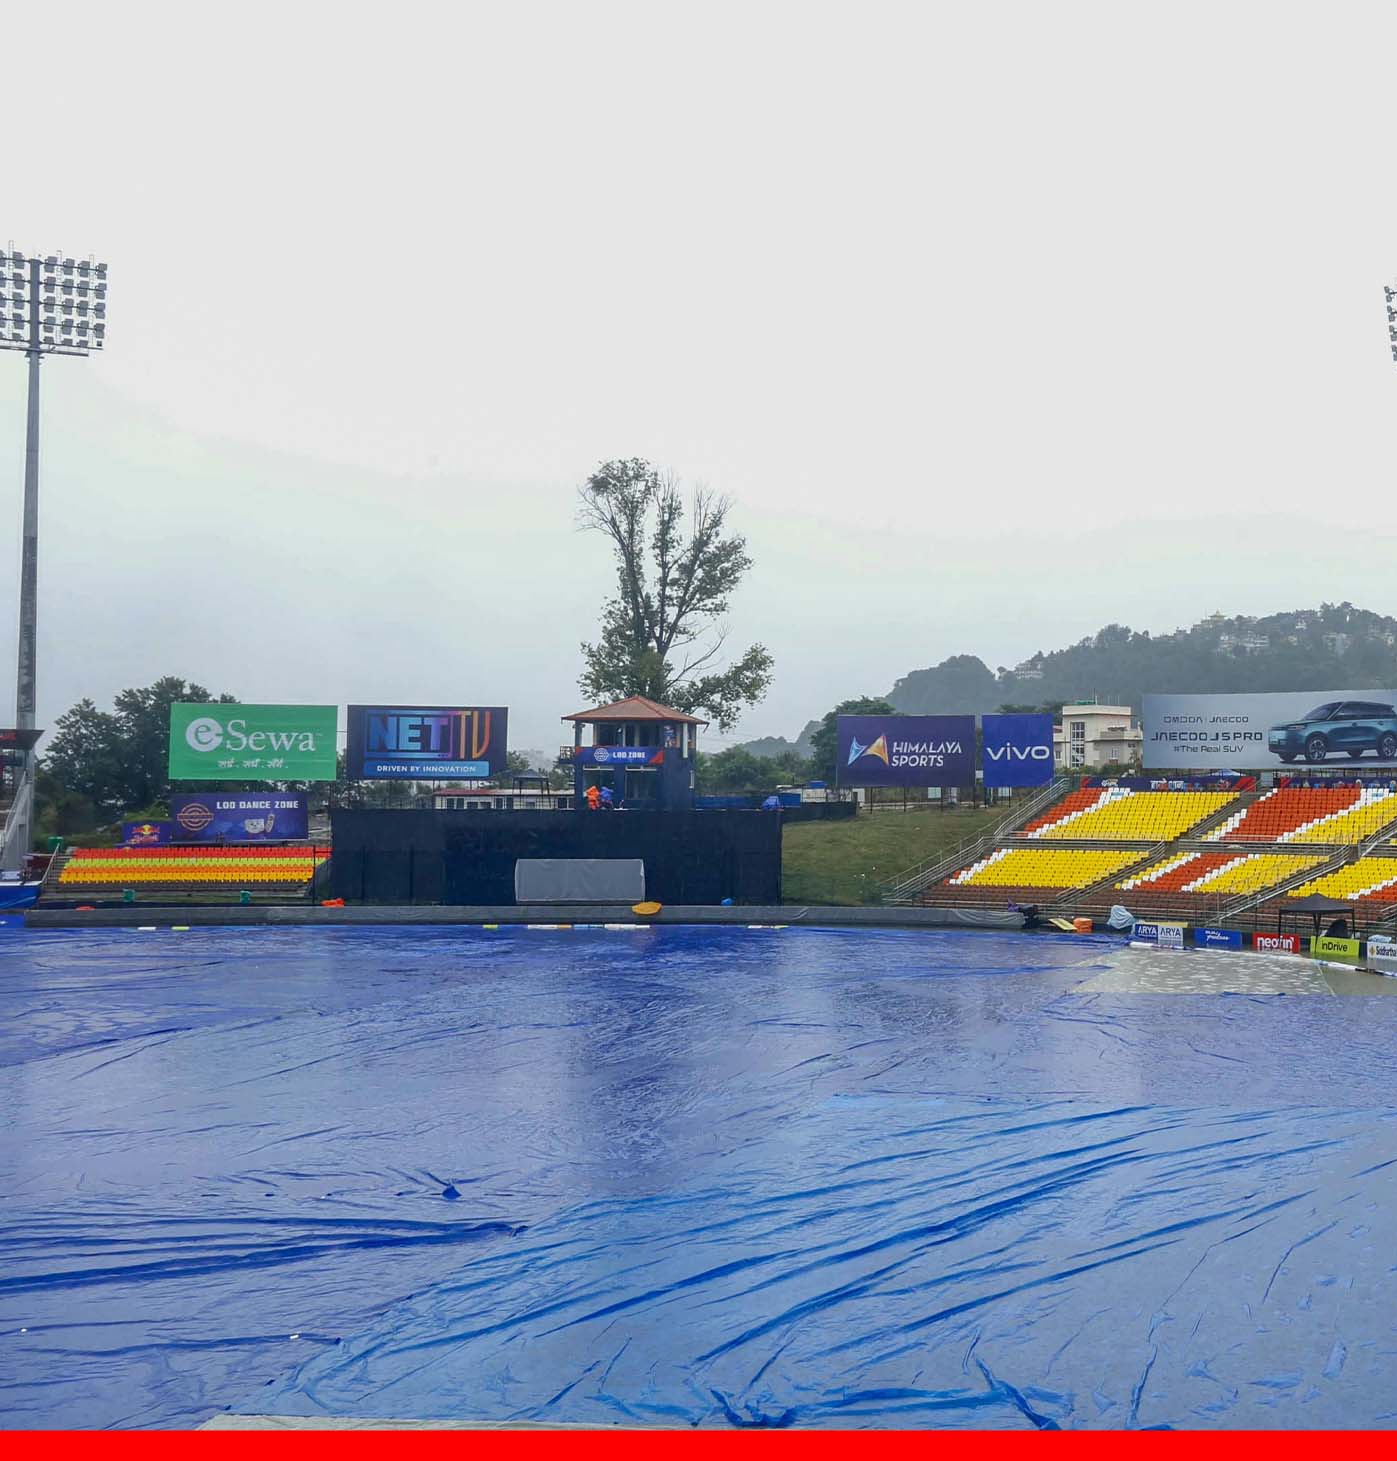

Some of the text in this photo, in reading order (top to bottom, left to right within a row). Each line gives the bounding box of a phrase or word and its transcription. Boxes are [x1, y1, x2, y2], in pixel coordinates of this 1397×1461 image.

[185, 717, 317, 752] eSewa
[1151, 732, 1208, 741] JAECOO
[1233, 732, 1263, 741] PRO
[893, 741, 962, 754] HIMALAYA
[986, 742, 1050, 761] vivo
[1200, 745, 1221, 753] Real
[1222, 745, 1245, 753] SUV
[891, 754, 944, 767] SPORTS
[376, 765, 477, 773] DRIVEN BY INNOVATION
[239, 801, 271, 809] DANCE
[274, 800, 300, 809] ZONE
[1138, 925, 1181, 937] ARYA ARYA
